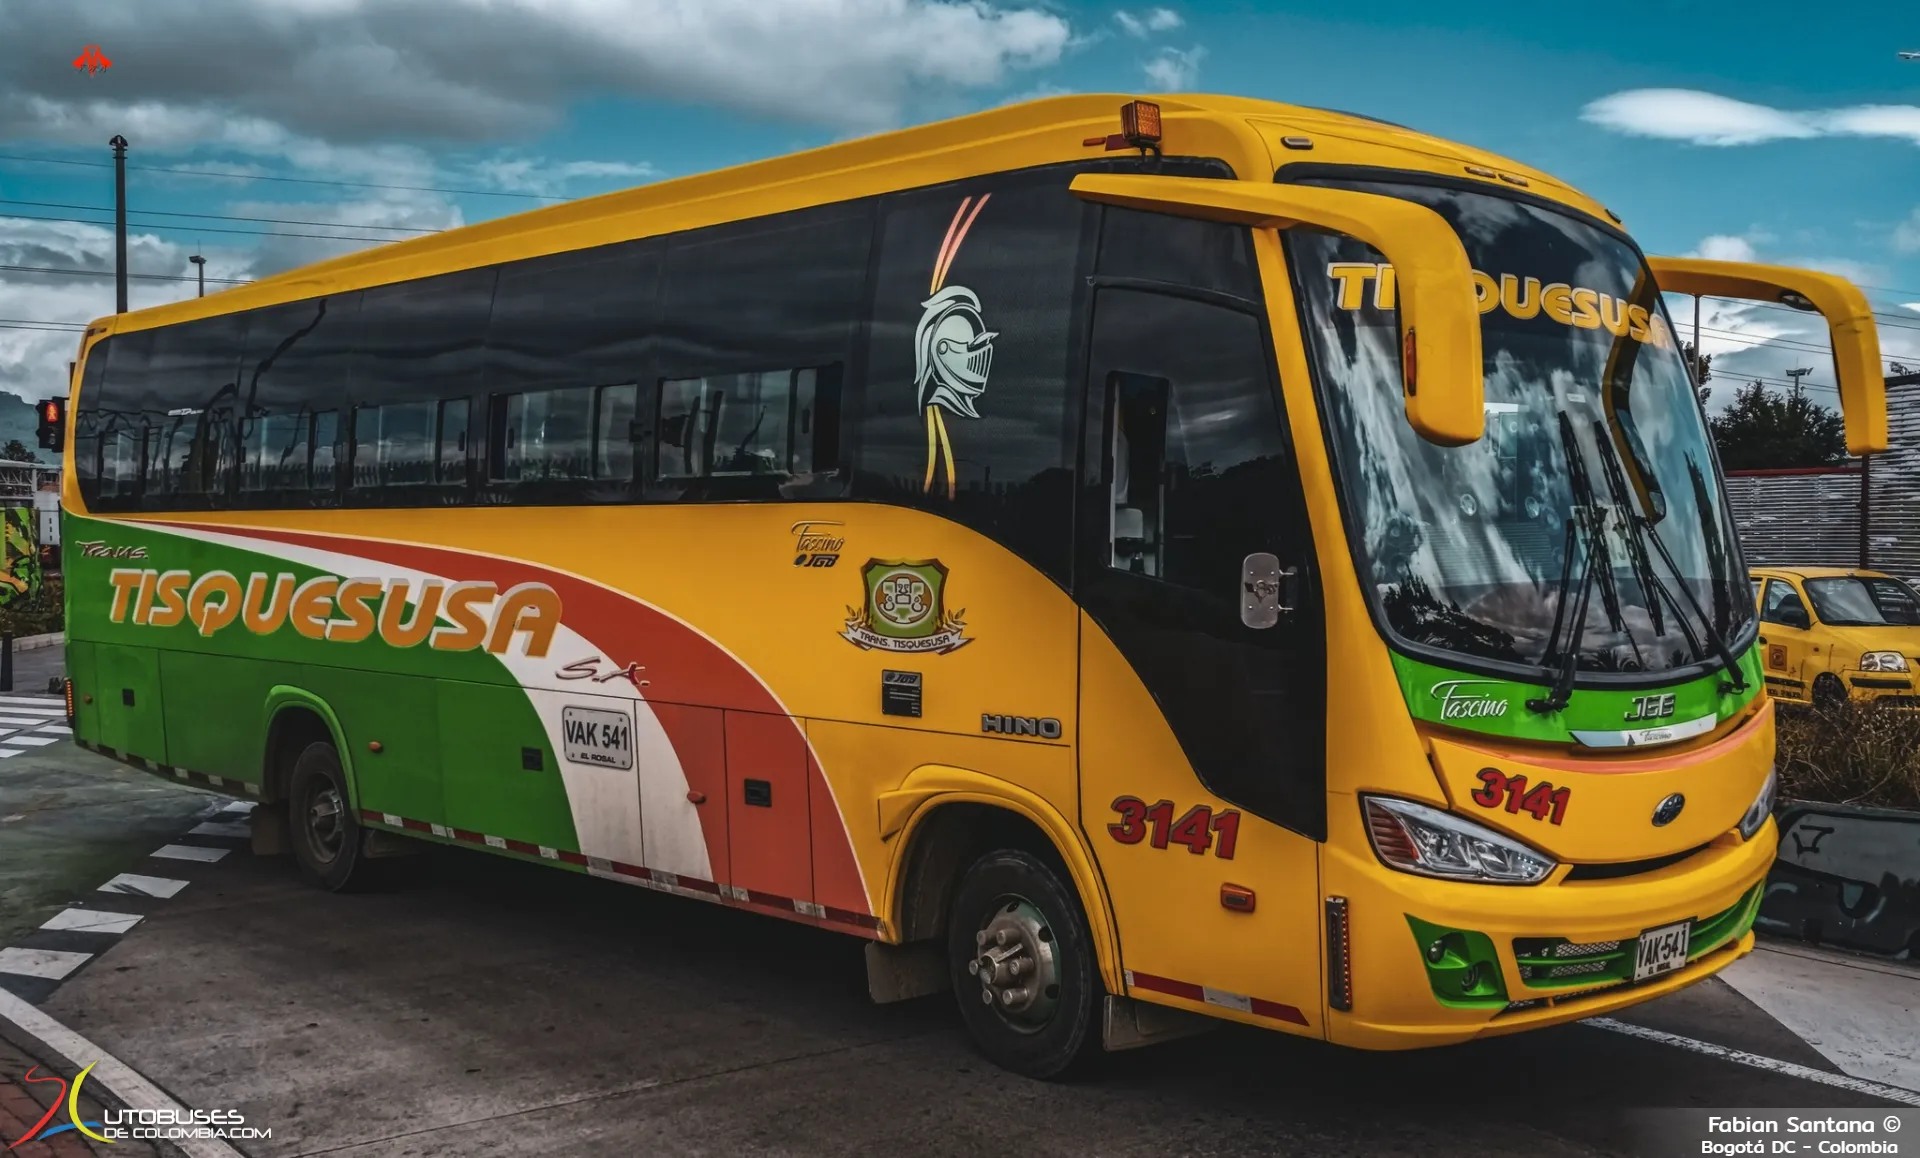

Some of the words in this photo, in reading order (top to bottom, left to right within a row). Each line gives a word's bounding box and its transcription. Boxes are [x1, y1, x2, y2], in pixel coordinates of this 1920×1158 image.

[1326, 262, 1673, 350] TIUESUSA
[791, 520, 845, 552] Fascino
[109, 567, 563, 658] TISQUESUSA
[860, 631, 891, 648] TRANS.
[893, 633, 951, 651] TISQUESUSA
[1430, 679, 1509, 721] Fascino
[565, 720, 598, 748] VAK
[602, 724, 628, 752] 541
[981, 714, 1062, 740] HINO
[580, 752, 590, 760] EL
[591, 754, 617, 765] ROSAL
[1471, 767, 1572, 826] 3141
[1107, 794, 1241, 861] 3141
